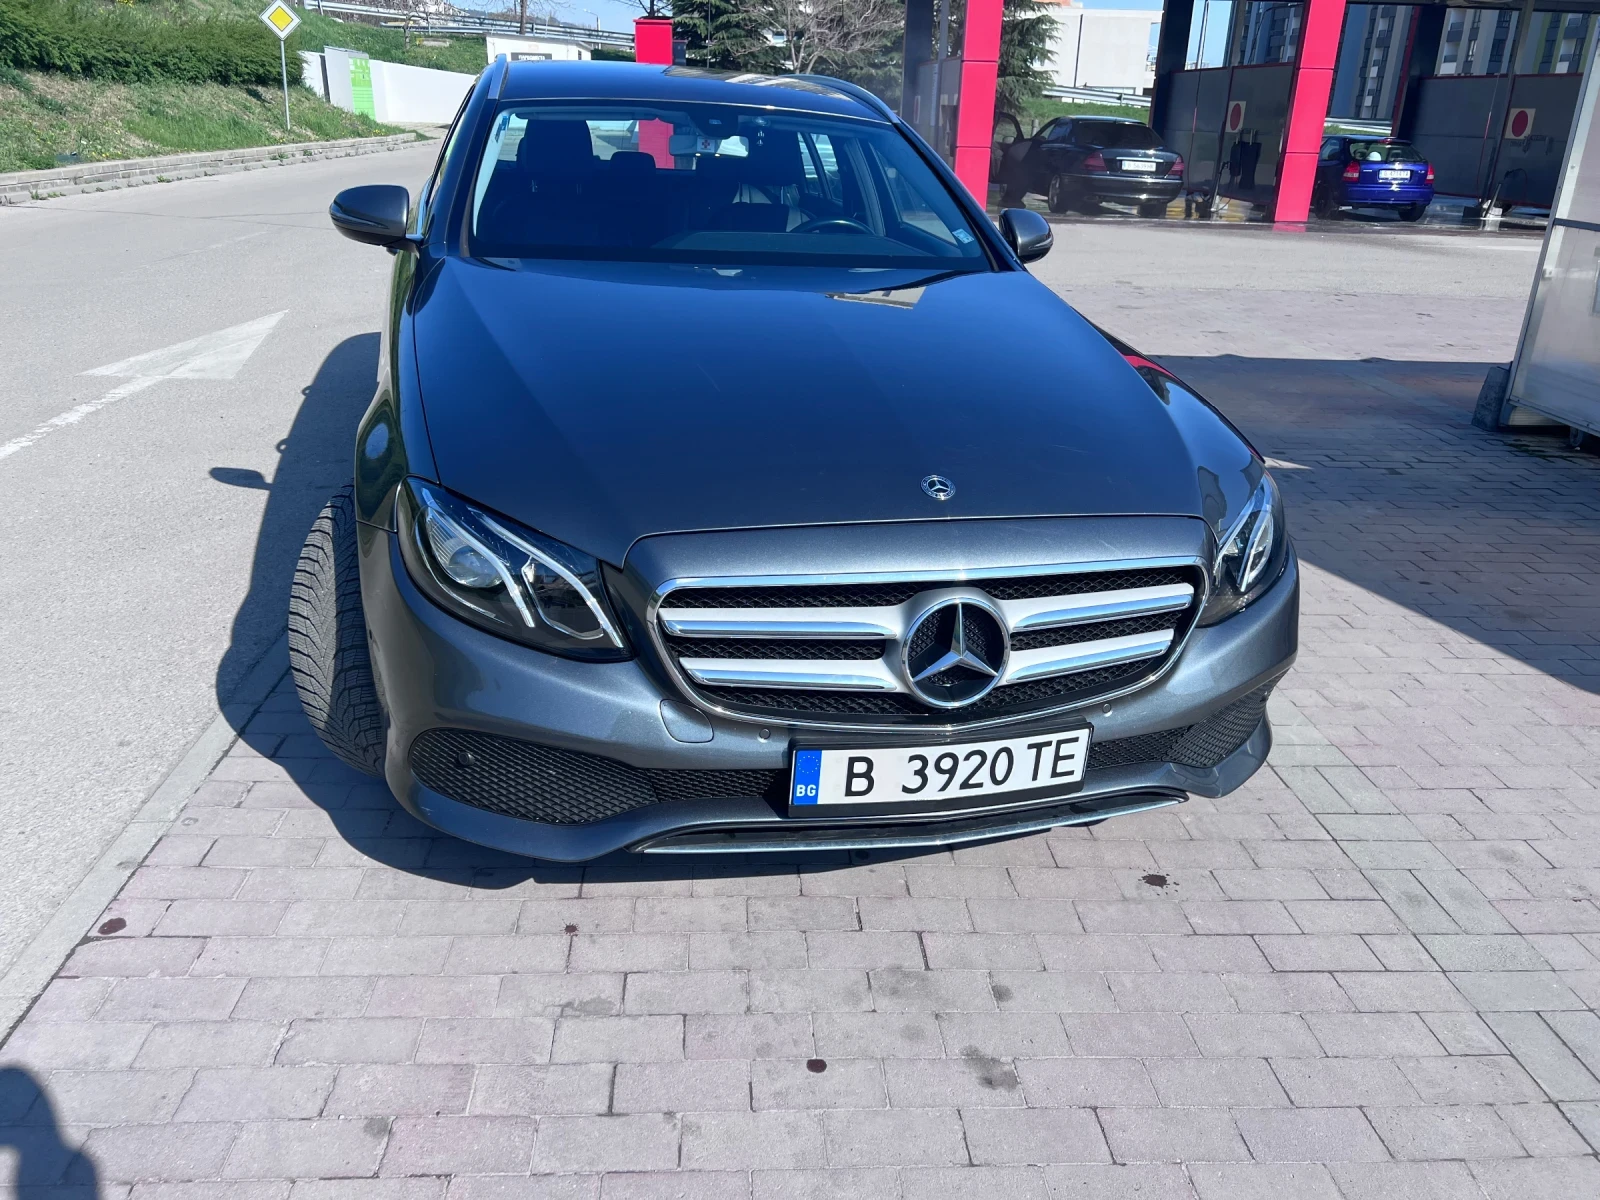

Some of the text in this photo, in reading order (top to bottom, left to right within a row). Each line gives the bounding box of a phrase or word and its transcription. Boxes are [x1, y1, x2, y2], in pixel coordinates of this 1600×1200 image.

[796, 736, 1080, 797] BG B 3920 TE
